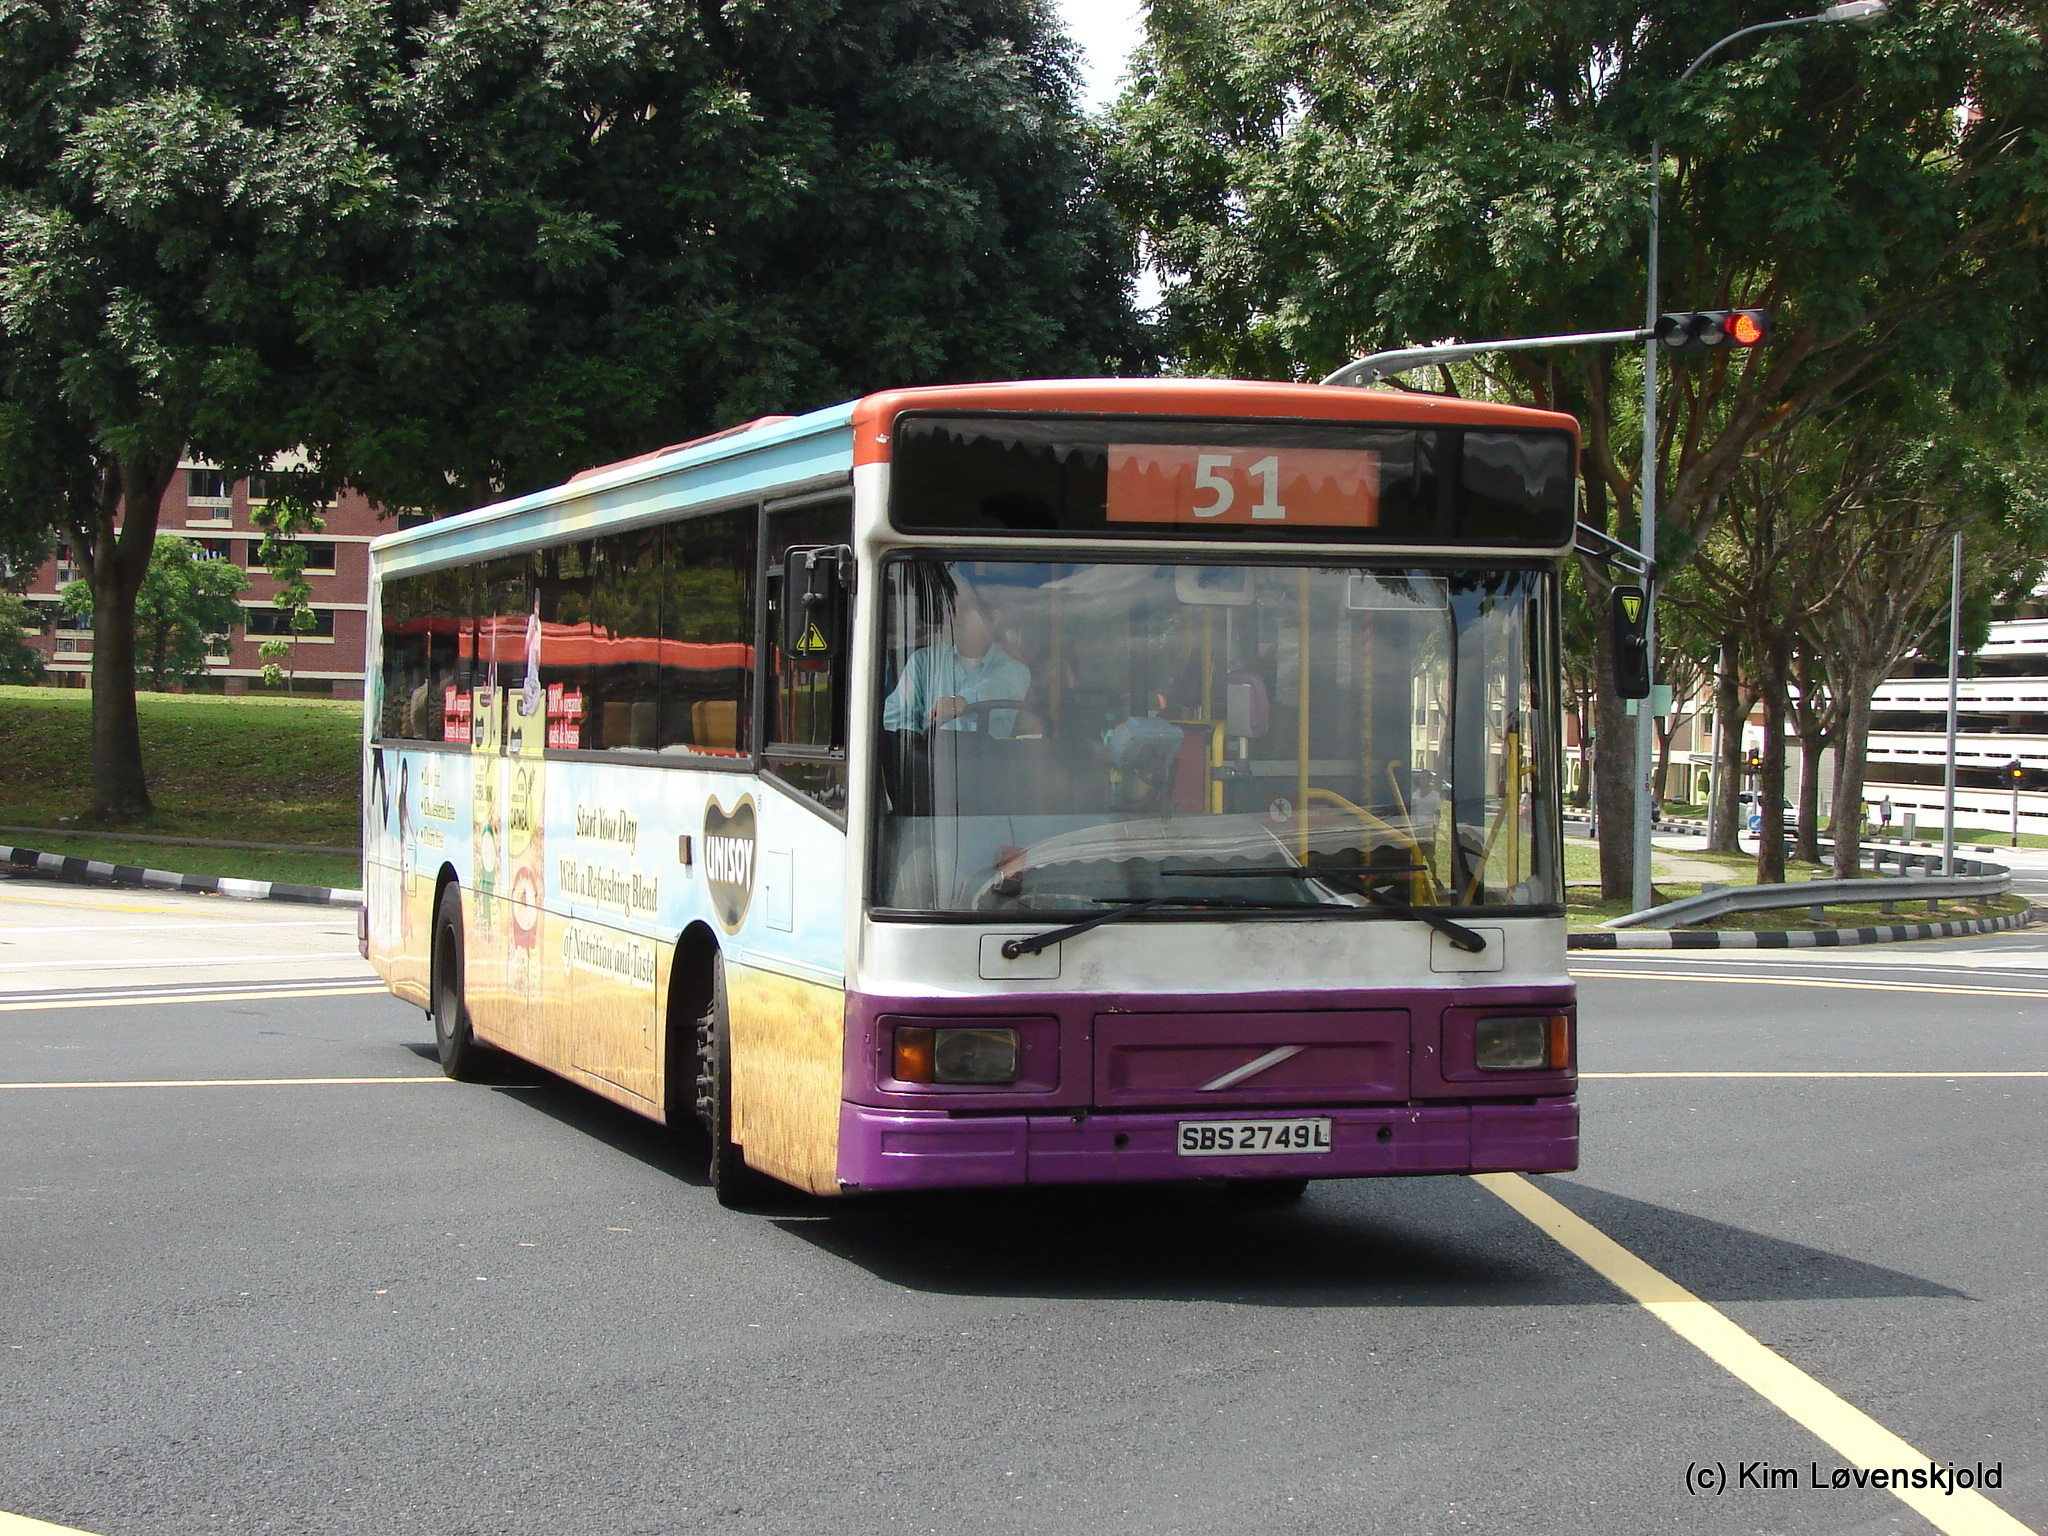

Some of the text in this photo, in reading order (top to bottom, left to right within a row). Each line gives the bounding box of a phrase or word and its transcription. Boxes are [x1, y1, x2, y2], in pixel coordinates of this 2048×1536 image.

[1192, 454, 1286, 519] 51
[548, 687, 582, 719] 100% organic
[576, 804, 637, 856] Start Your Day
[559, 860, 657, 918] With a Refreshing Blend
[706, 835, 754, 894] UNISOY
[563, 926, 655, 984] of Nutrition and Taste
[1182, 1124, 1330, 1150] SBS2749L
